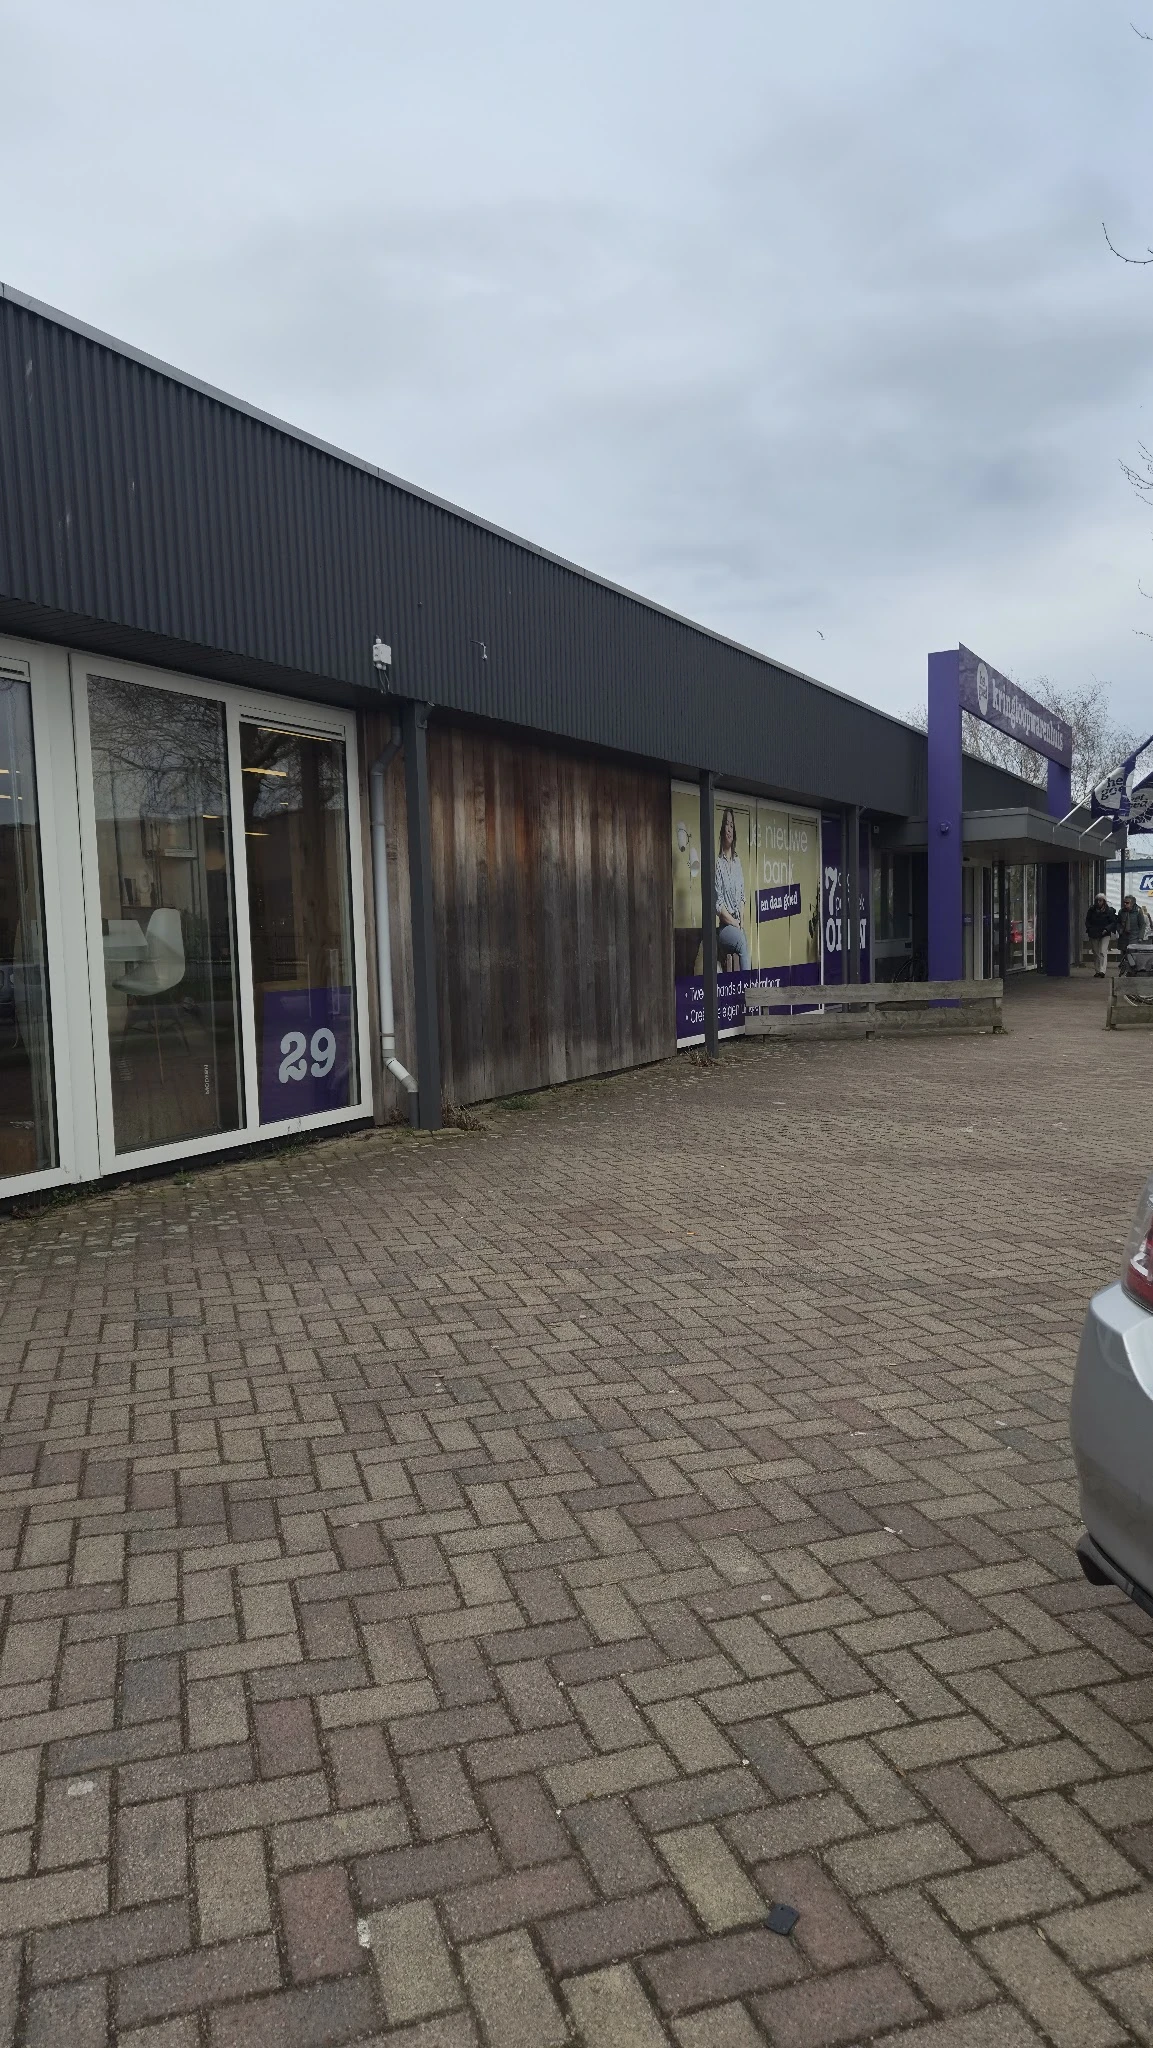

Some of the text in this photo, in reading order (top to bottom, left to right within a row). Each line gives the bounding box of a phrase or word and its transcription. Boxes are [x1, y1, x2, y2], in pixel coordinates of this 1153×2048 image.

[992, 678, 1064, 752] kringloopwarenhuis
[747, 819, 808, 853] Je nieuwe
[763, 853, 795, 885] bank
[760, 899, 770, 912] en
[769, 895, 783, 910] dan
[824, 866, 838, 916] 7
[279, 1027, 337, 1084] 29
